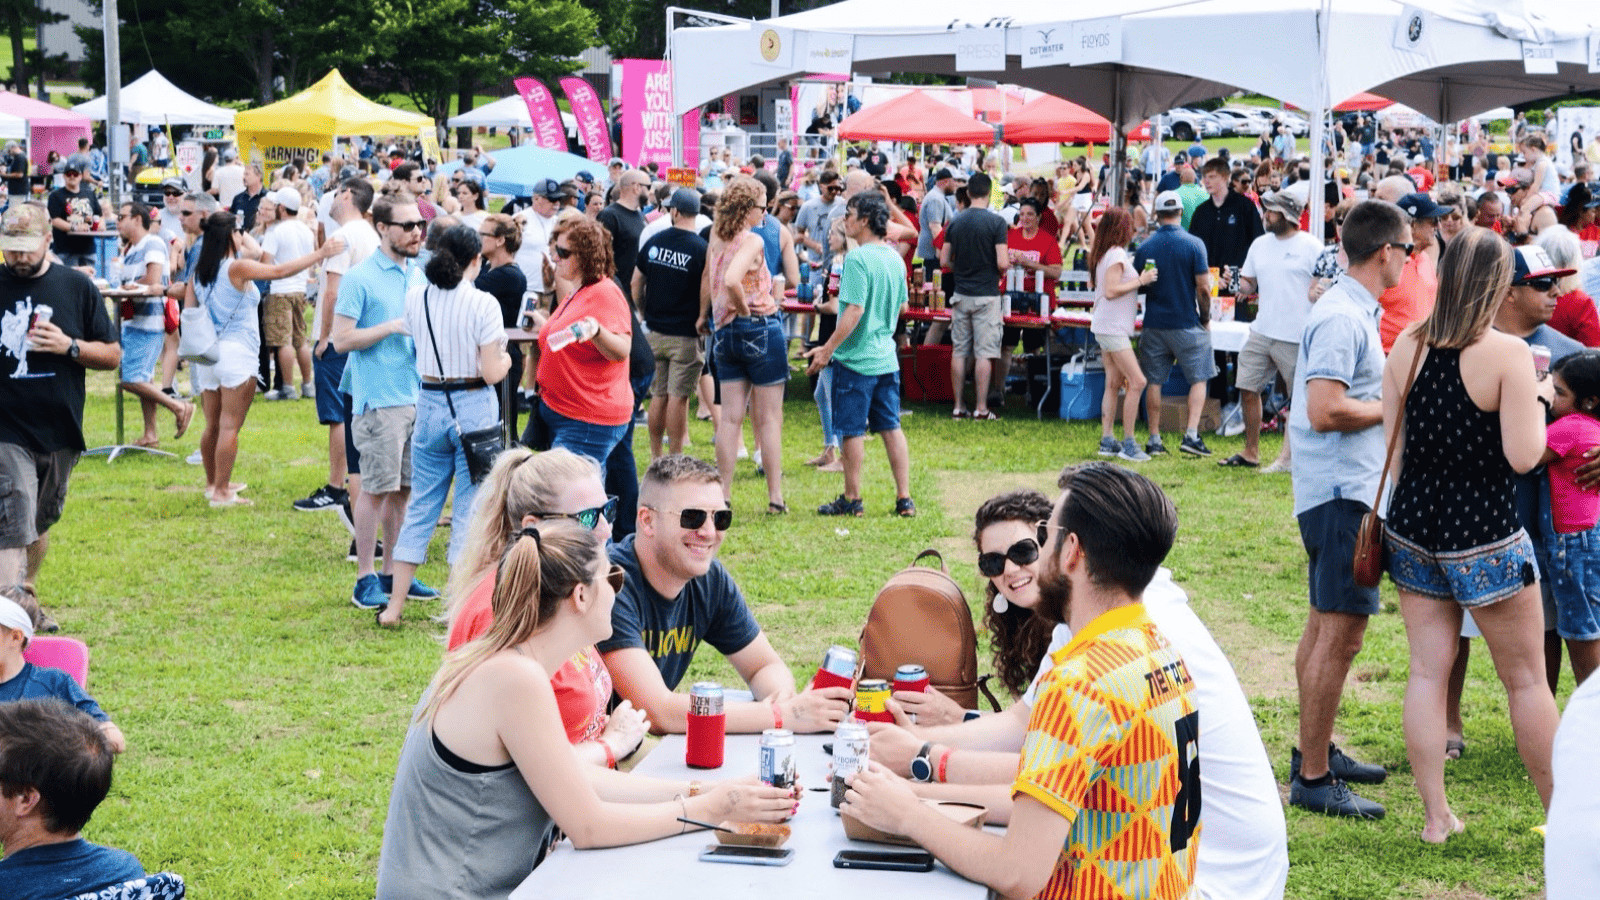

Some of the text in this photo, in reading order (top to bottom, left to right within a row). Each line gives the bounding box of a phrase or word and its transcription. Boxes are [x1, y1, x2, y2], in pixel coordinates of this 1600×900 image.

[1029, 43, 1064, 55] CUTWATER
[1081, 33, 1110, 49] FLOYDS
[958, 44, 1000, 59] PRESS
[645, 72, 671, 91] ARE
[644, 92, 671, 110] YOU
[645, 131, 671, 149] US?
[657, 247, 692, 268] IFAW
